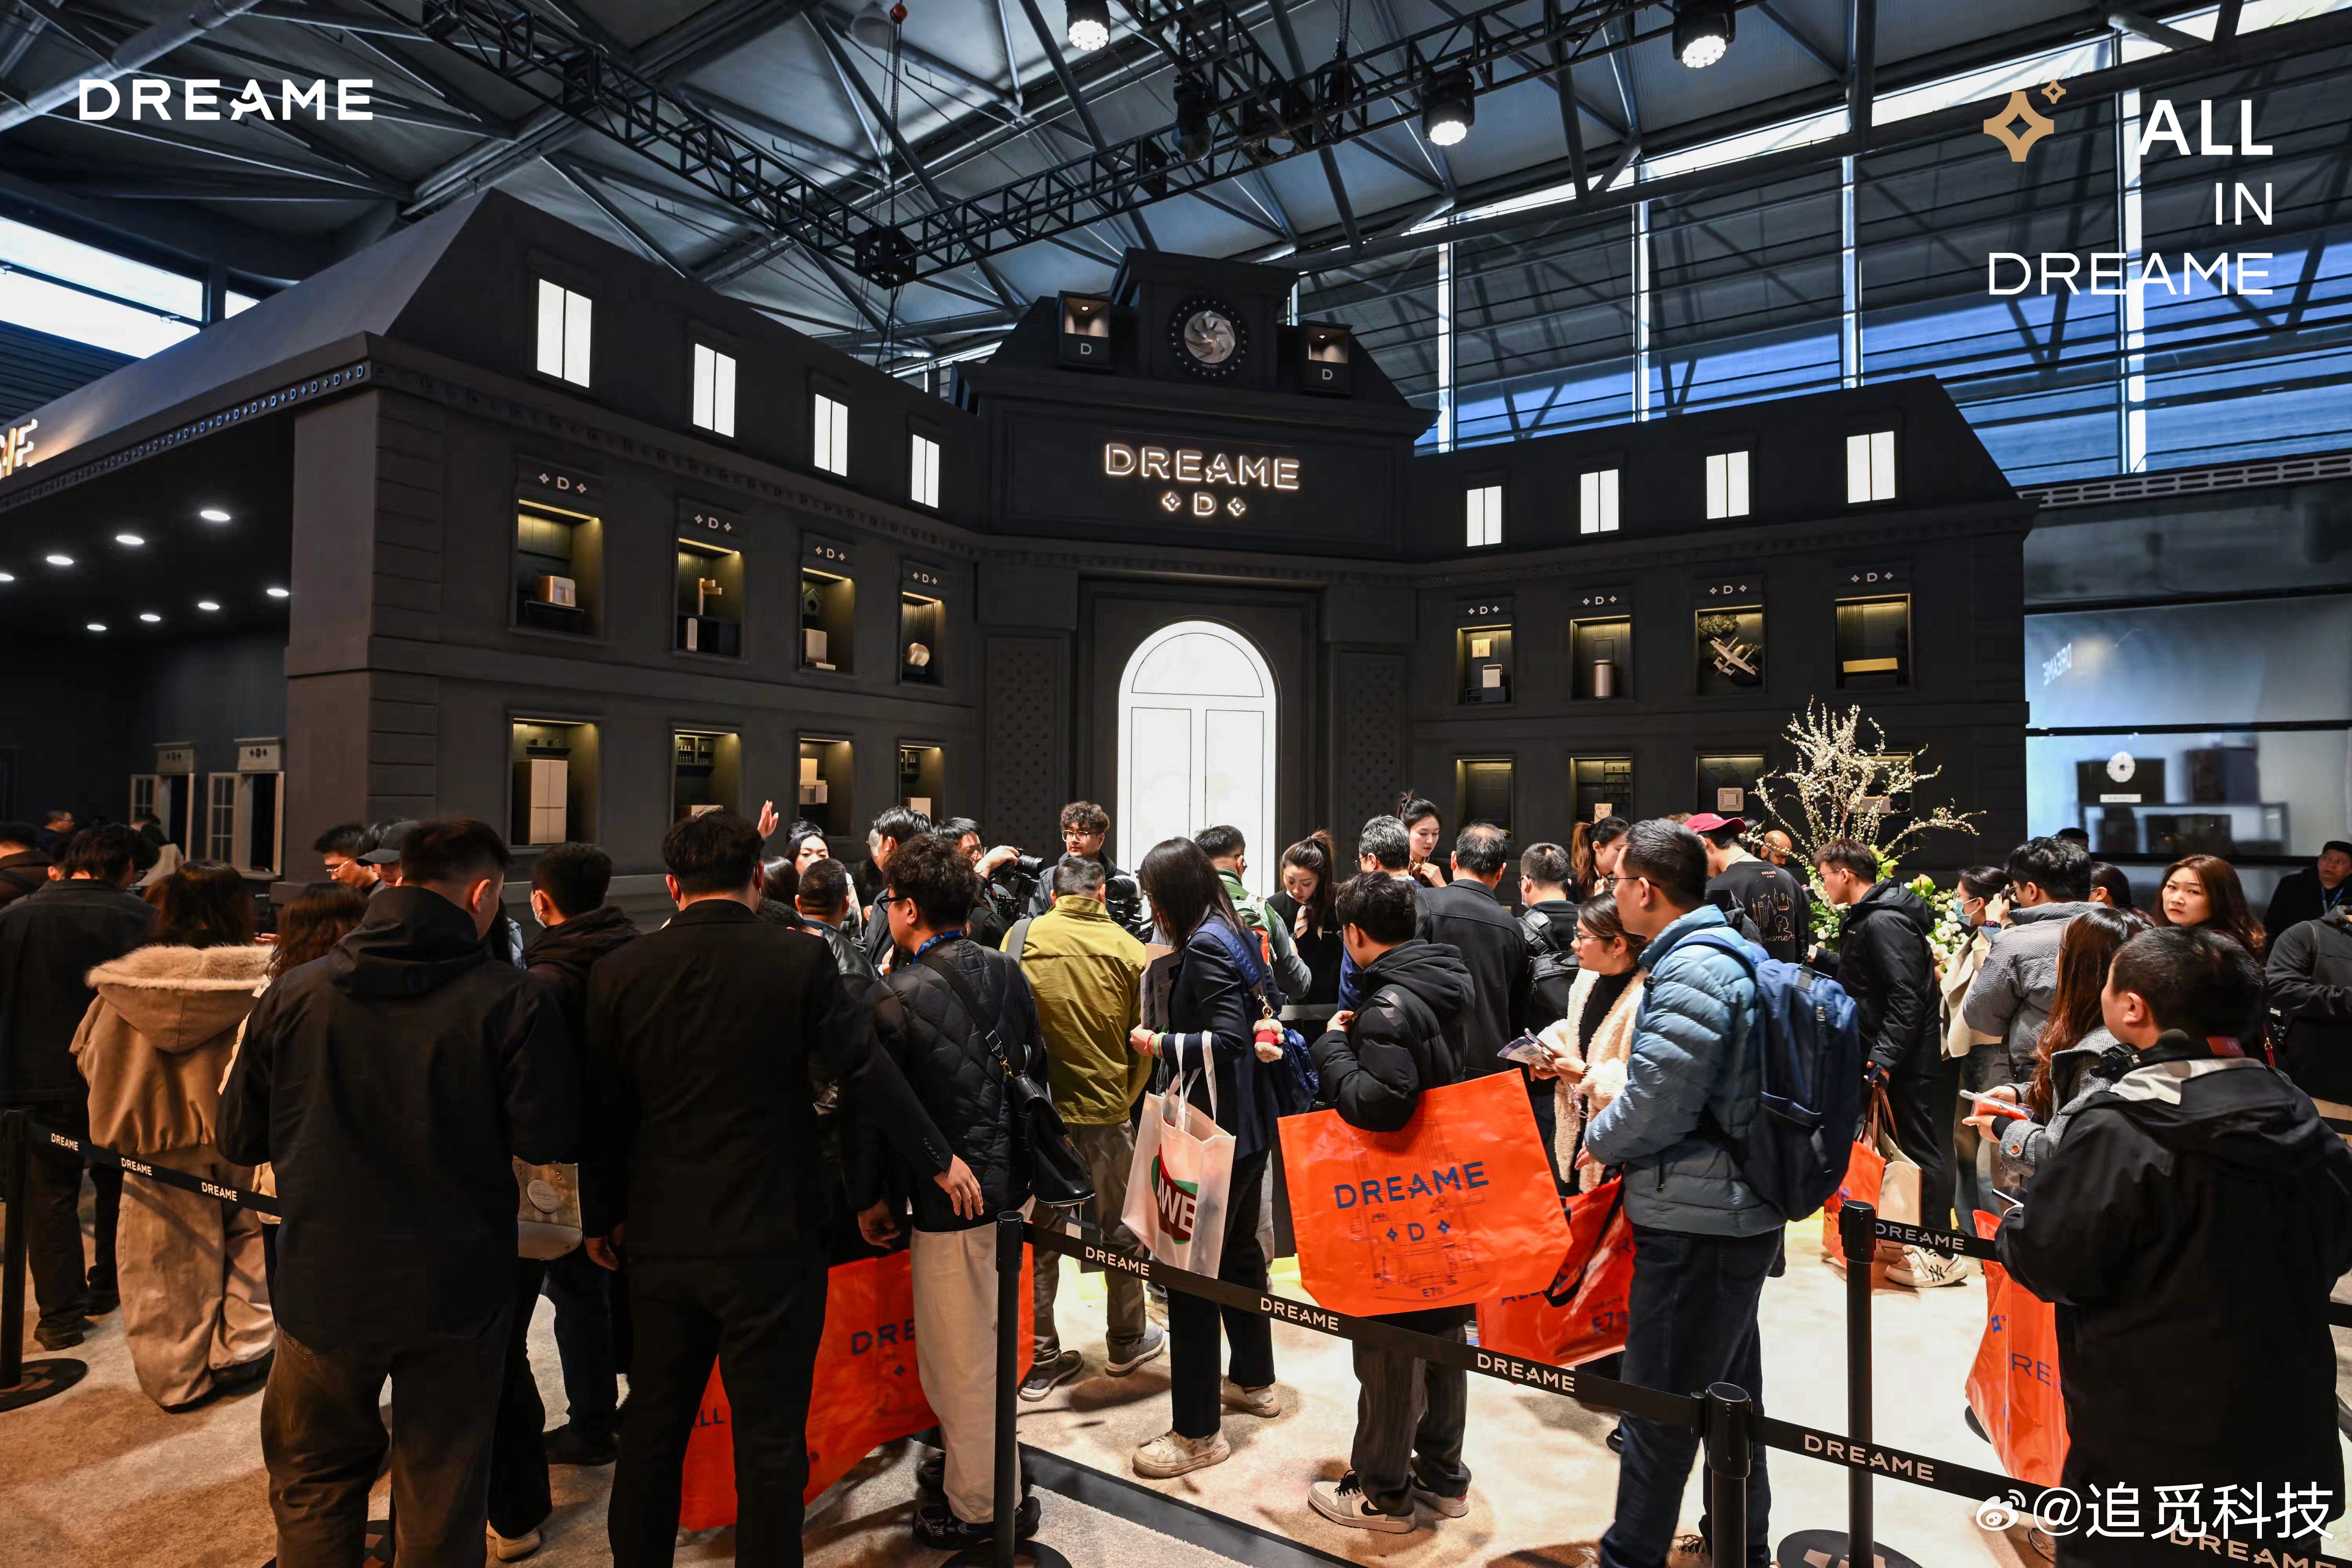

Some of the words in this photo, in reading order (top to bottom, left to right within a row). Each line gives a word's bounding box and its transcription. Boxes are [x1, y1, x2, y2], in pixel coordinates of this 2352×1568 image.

[1080, 343, 1092, 355] D
[1322, 368, 1333, 380] D
[1104, 443, 1301, 490] DREAME
[557, 476, 569, 490] D
[1193, 492, 1217, 517] D
[708, 517, 719, 529] D
[826, 548, 835, 559] D
[922, 573, 929, 583] D
[1867, 573, 1878, 582] D
[1723, 585, 1733, 595] D
[1480, 606, 1488, 614] D
[1595, 596, 1604, 605] D
[51, 1133, 79, 1152] DREAME
[121, 1157, 152, 1176] DREAME
[201, 1181, 237, 1201] DREAME
[1334, 1161, 1489, 1209] DREAME
[1408, 1223, 1425, 1241] D
[1085, 1246, 1150, 1277] DREAME
[1260, 1297, 1339, 1332] DREAME
[852, 1318, 916, 1356] DRE
[1477, 1352, 1575, 1392] DREAME
[693, 1408, 725, 1428] LL
[1804, 1434, 1935, 1482] DREAME
